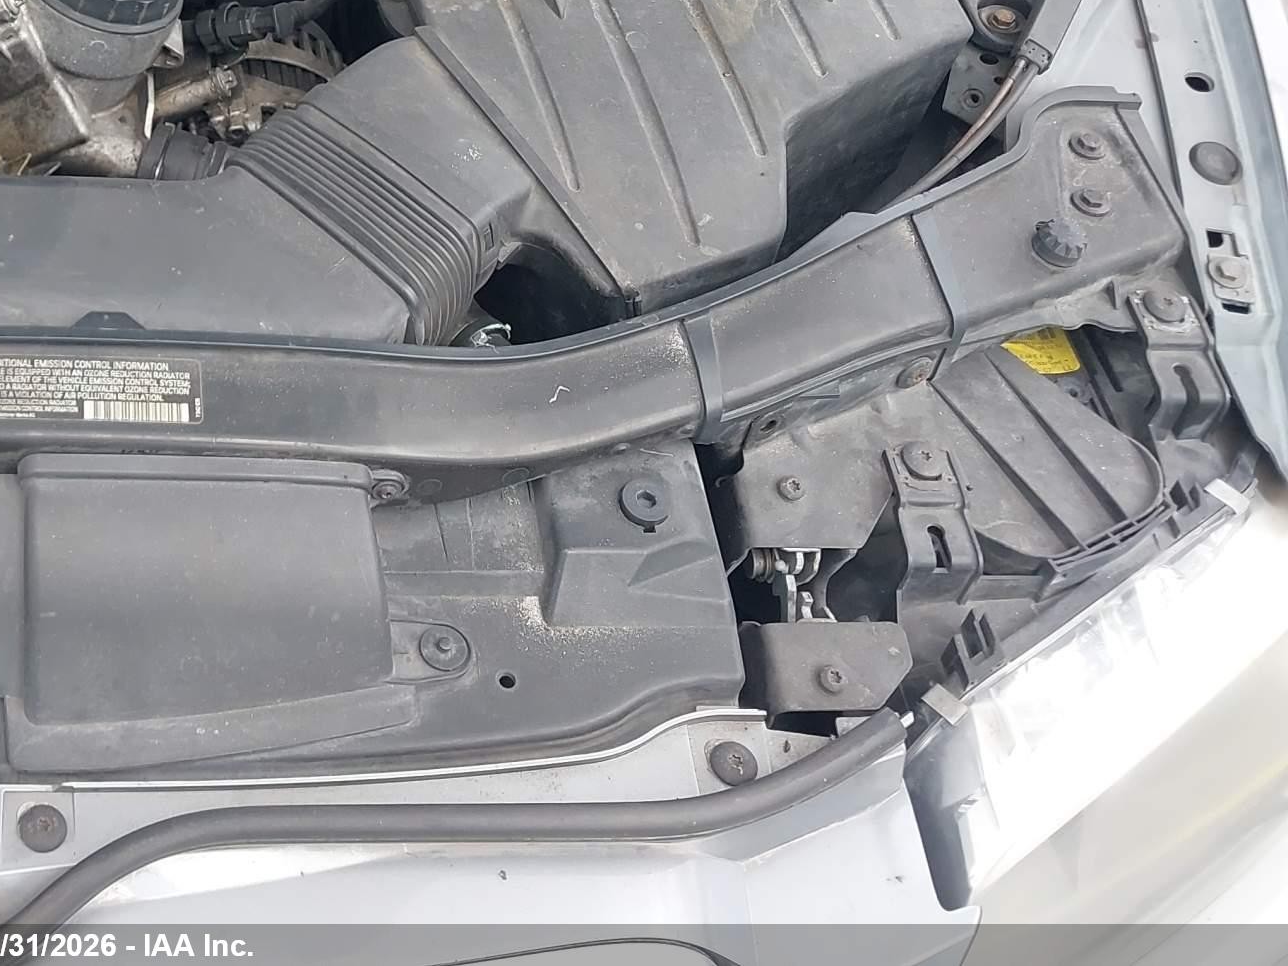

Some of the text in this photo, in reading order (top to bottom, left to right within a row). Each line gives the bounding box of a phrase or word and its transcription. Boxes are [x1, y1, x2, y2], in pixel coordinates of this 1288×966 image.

[34, 359, 73, 368] EMISSION
[74, 360, 111, 369] CONTROL
[113, 362, 168, 371] INFORMATION
[153, 372, 190, 380] RADIATOR
[58, 377, 88, 385] VEHICLE
[125, 378, 158, 386] CONTROL
[81, 385, 124, 393] EQUIVALENT
[149, 387, 190, 395] REDUCTION
[77, 392, 116, 400] POLLUTION
[117, 394, 164, 402] REGULATION.
